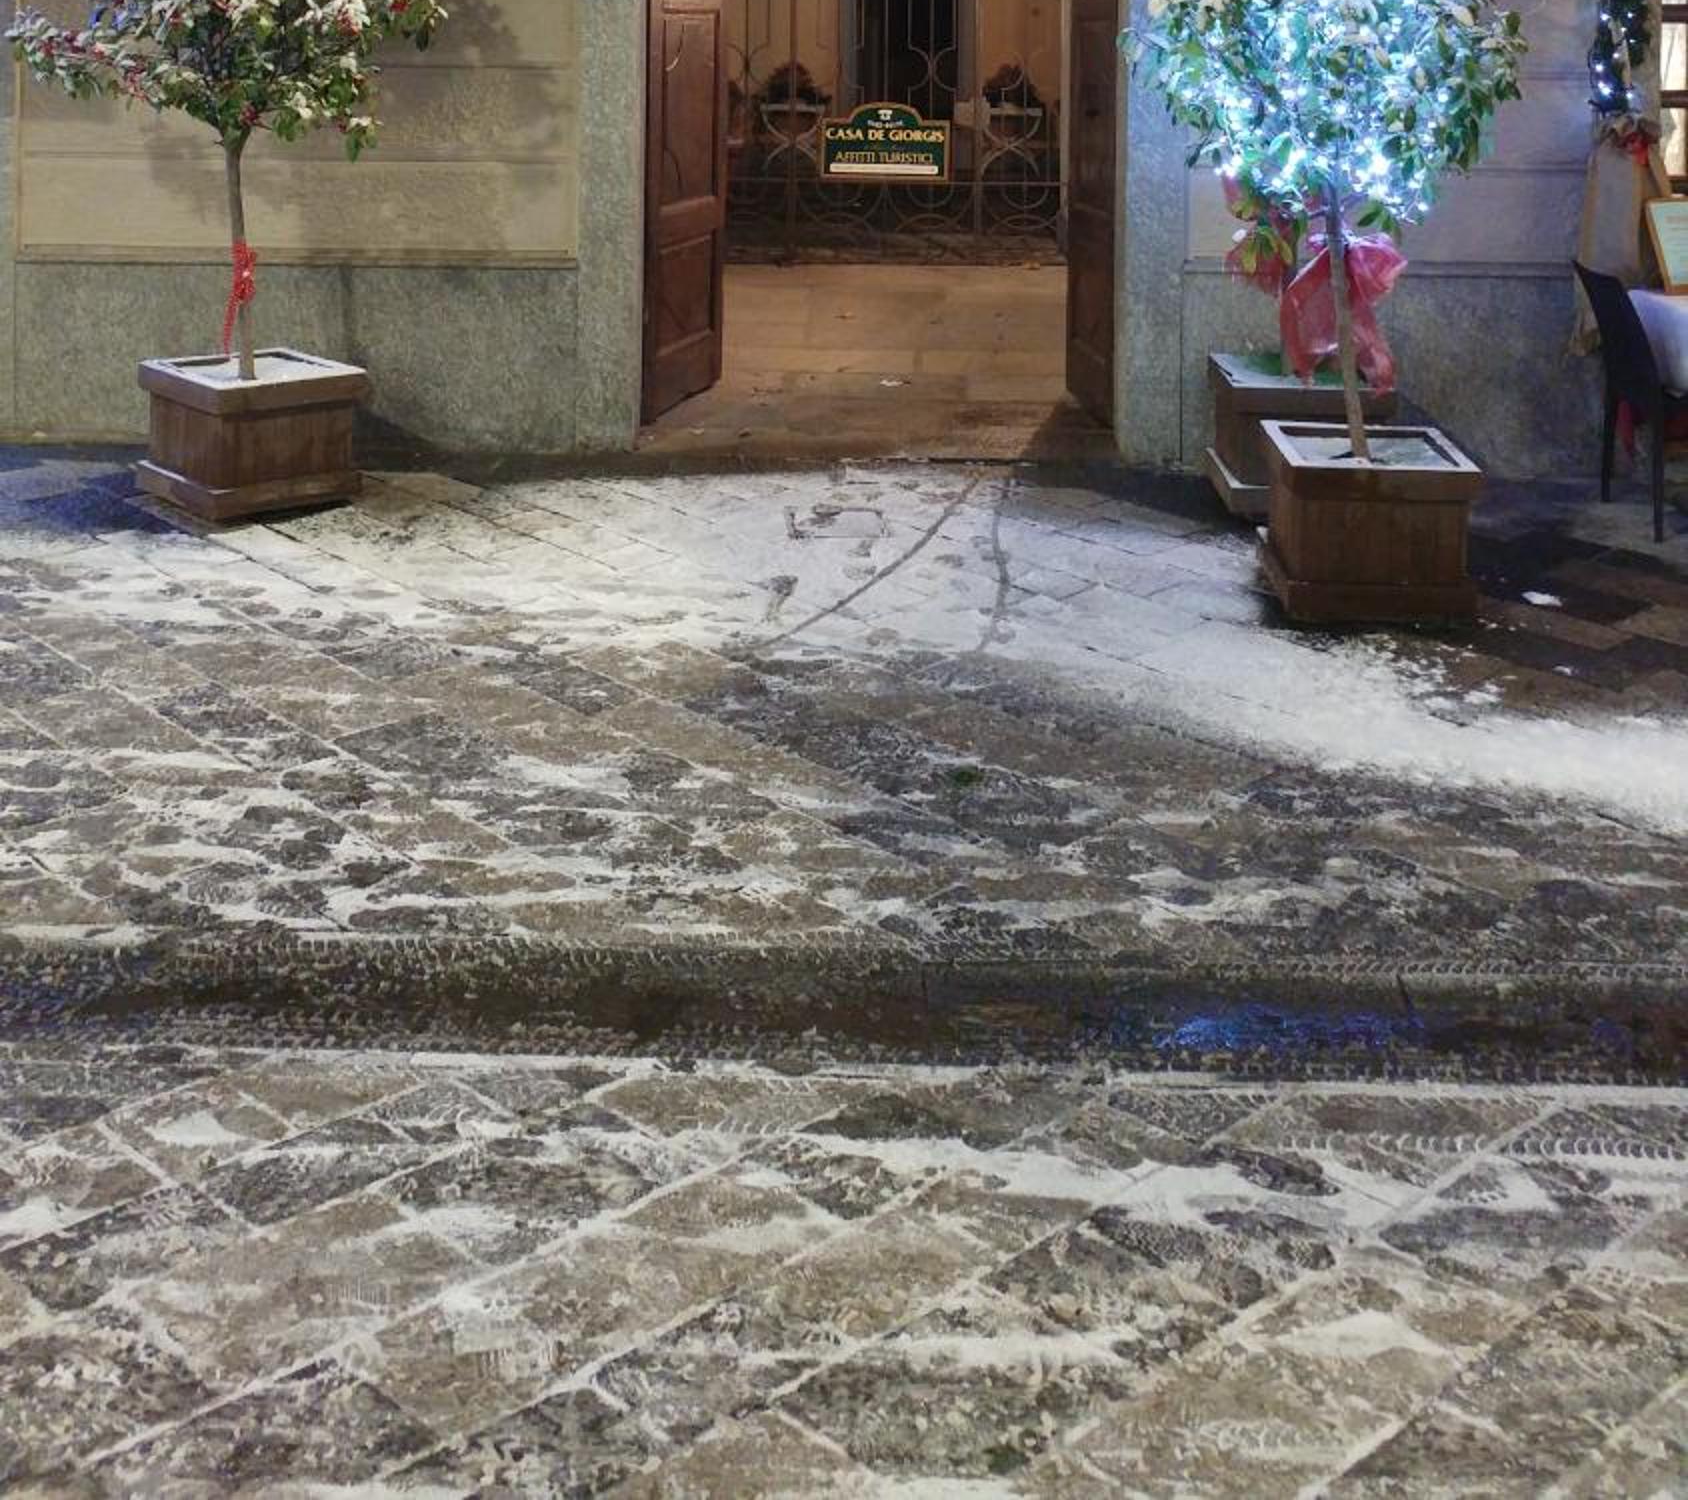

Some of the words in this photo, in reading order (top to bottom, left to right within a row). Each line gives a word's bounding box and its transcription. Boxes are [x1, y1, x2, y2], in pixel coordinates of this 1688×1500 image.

[826, 128, 863, 140] CASA
[868, 129, 885, 141] DE
[889, 129, 945, 142] GIORGIS
[835, 151, 875, 163] AFFITTI
[879, 151, 933, 164] TURISTICI
